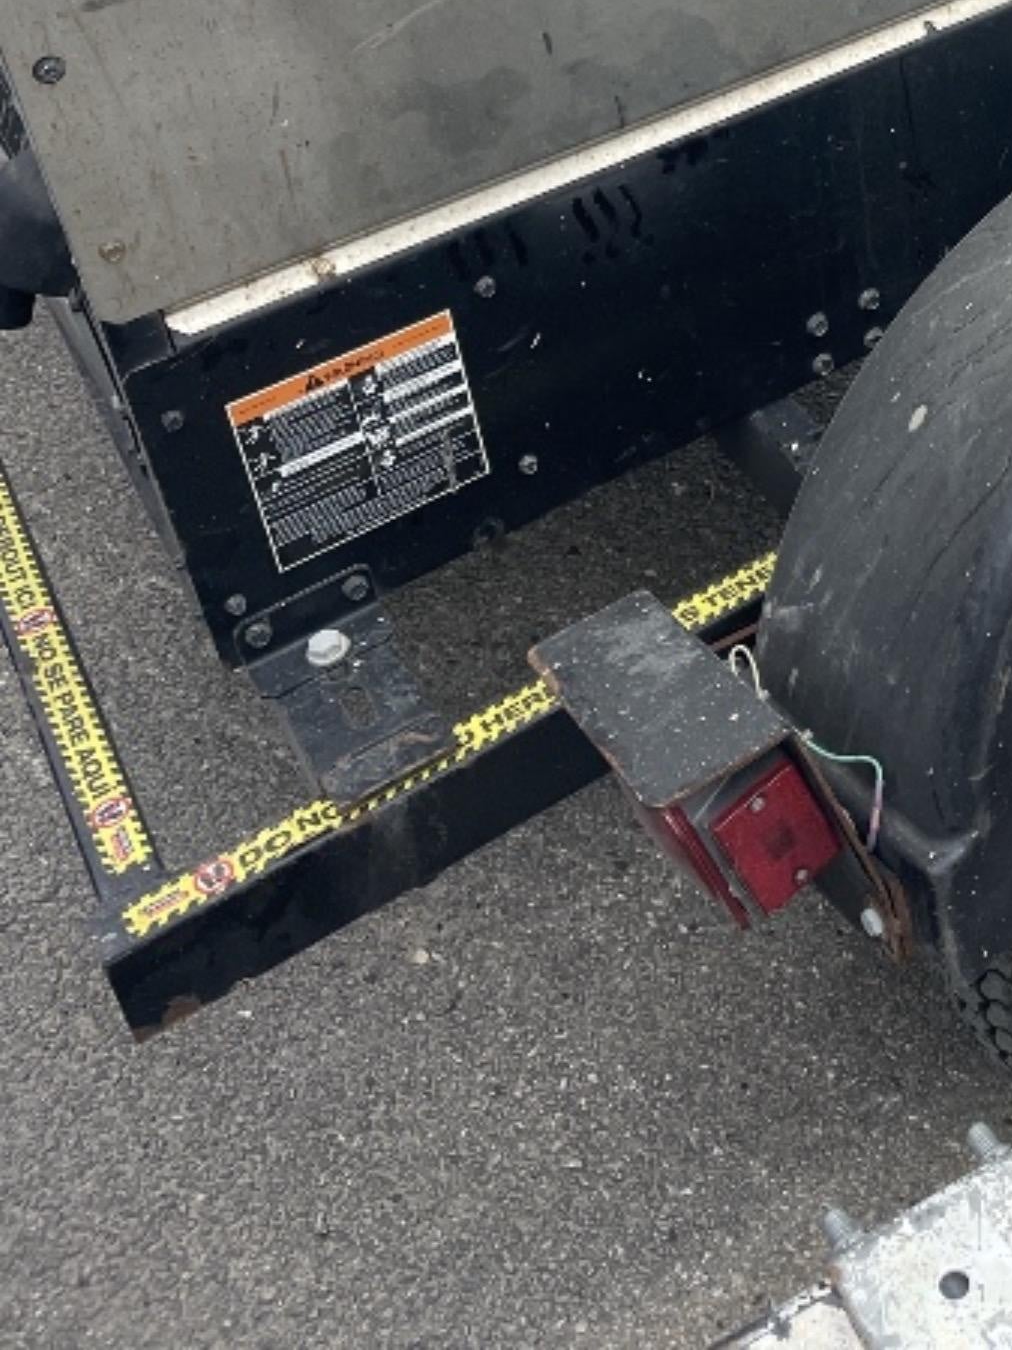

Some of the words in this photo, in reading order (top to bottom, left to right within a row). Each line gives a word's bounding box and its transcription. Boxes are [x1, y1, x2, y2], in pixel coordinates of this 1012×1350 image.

[54, 690, 91, 747] PARE
[238, 829, 293, 868] DO
[296, 803, 340, 832] NO
